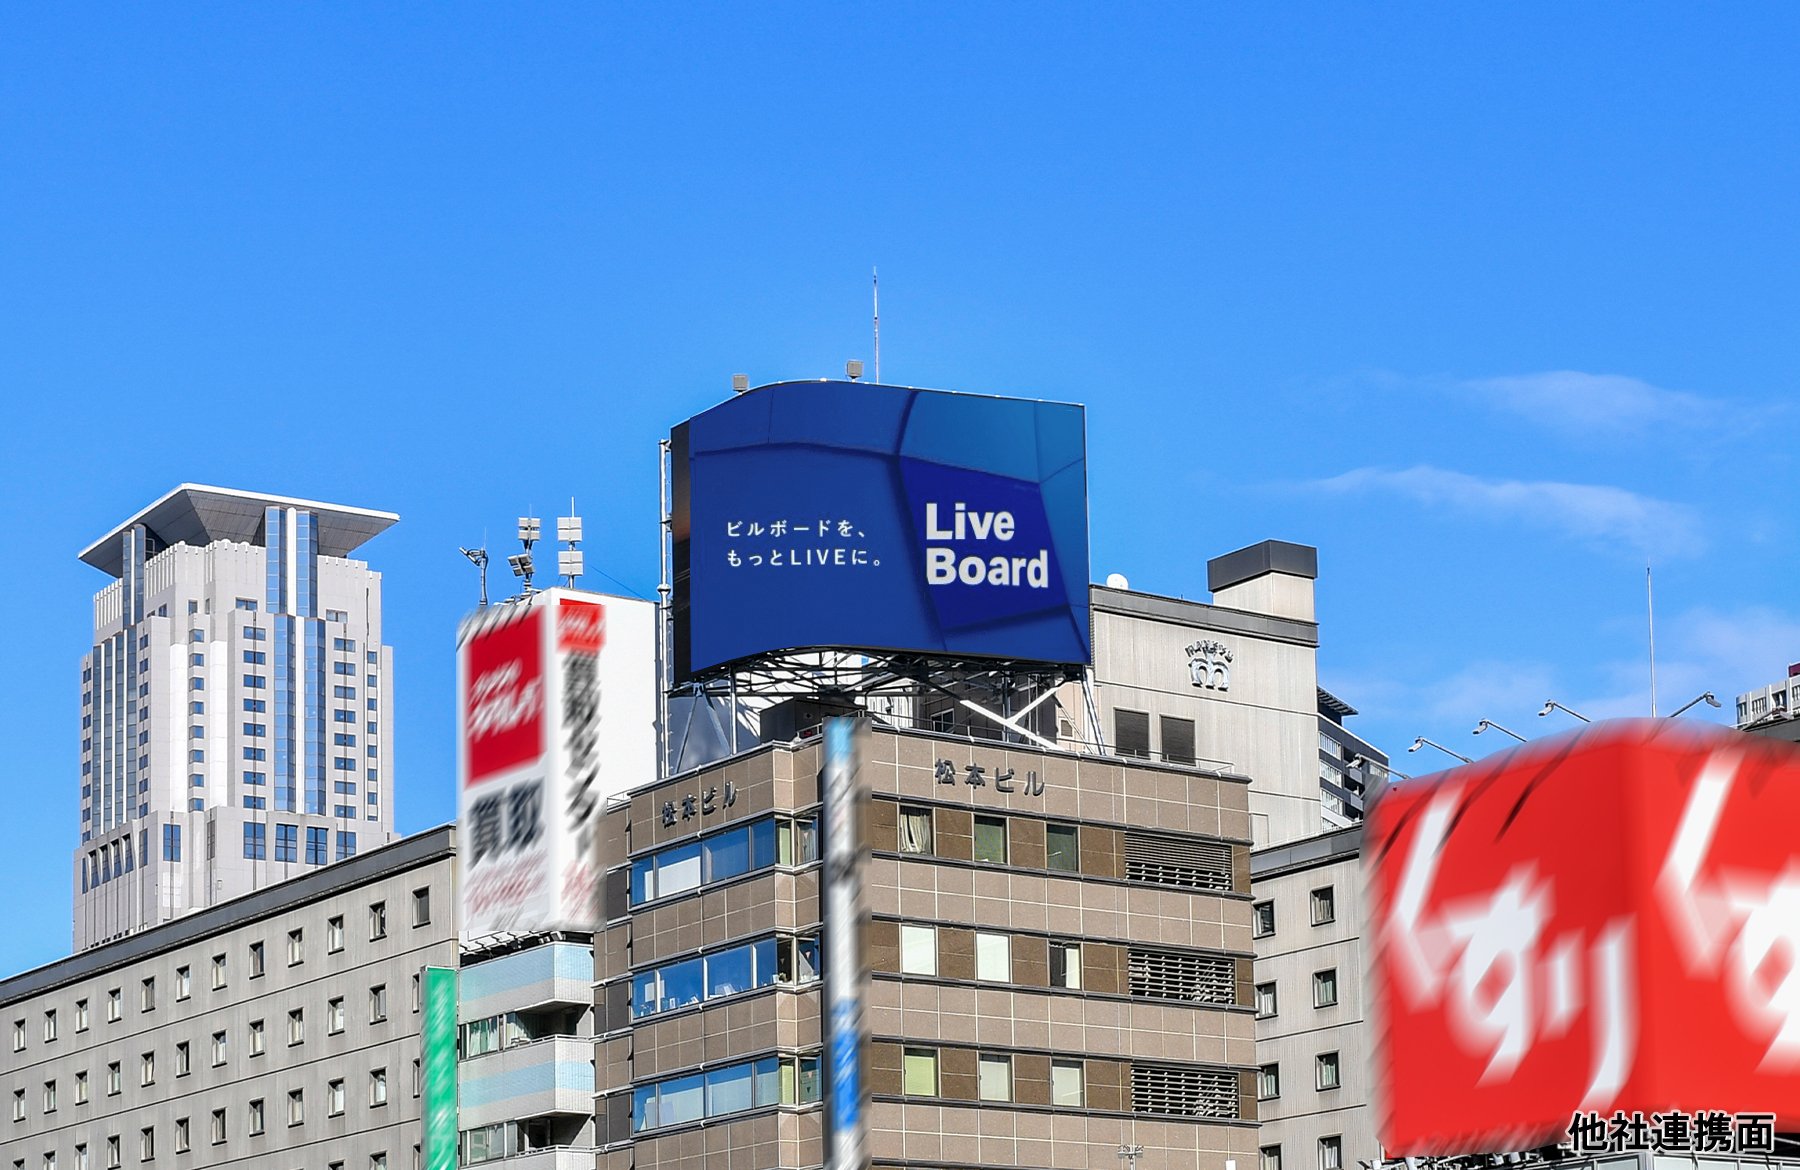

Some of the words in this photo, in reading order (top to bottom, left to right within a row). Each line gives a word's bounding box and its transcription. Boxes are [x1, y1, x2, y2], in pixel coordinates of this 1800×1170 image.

[727, 519, 865, 538] ビルボードを、
[926, 502, 1015, 541] Live
[727, 548, 880, 567] もっとLIVEに。
[926, 547, 1049, 588] Board
[935, 758, 1045, 797] 松本ビル
[662, 781, 740, 829] 松本ビル
